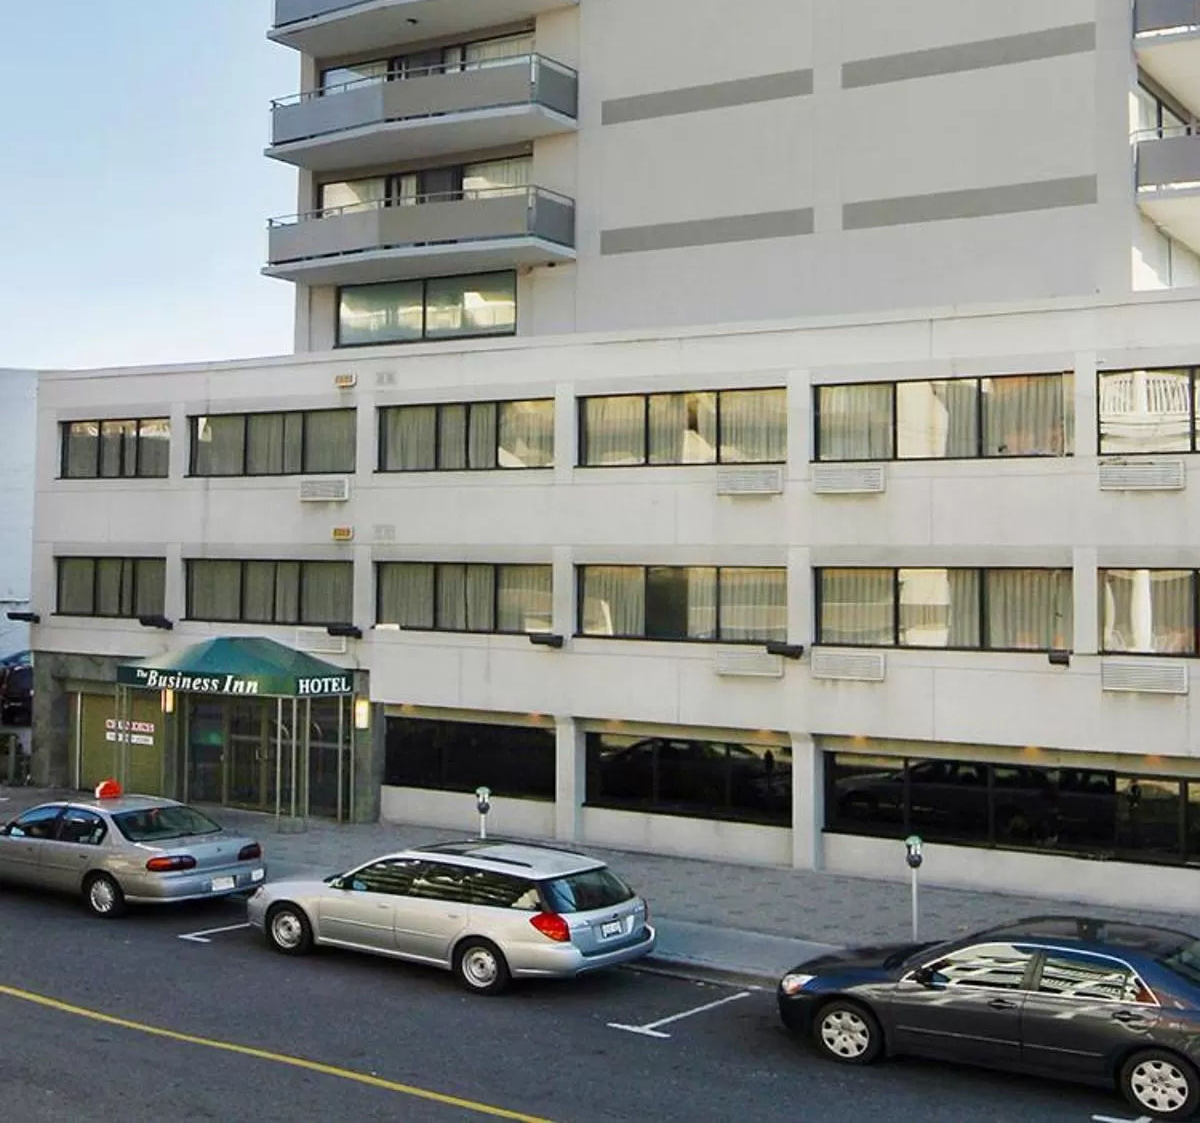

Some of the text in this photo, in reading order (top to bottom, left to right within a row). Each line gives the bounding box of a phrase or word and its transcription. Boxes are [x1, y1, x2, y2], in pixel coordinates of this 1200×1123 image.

[147, 669, 218, 692] Business
[222, 674, 259, 694] Inn
[298, 677, 351, 694] HOTEL
